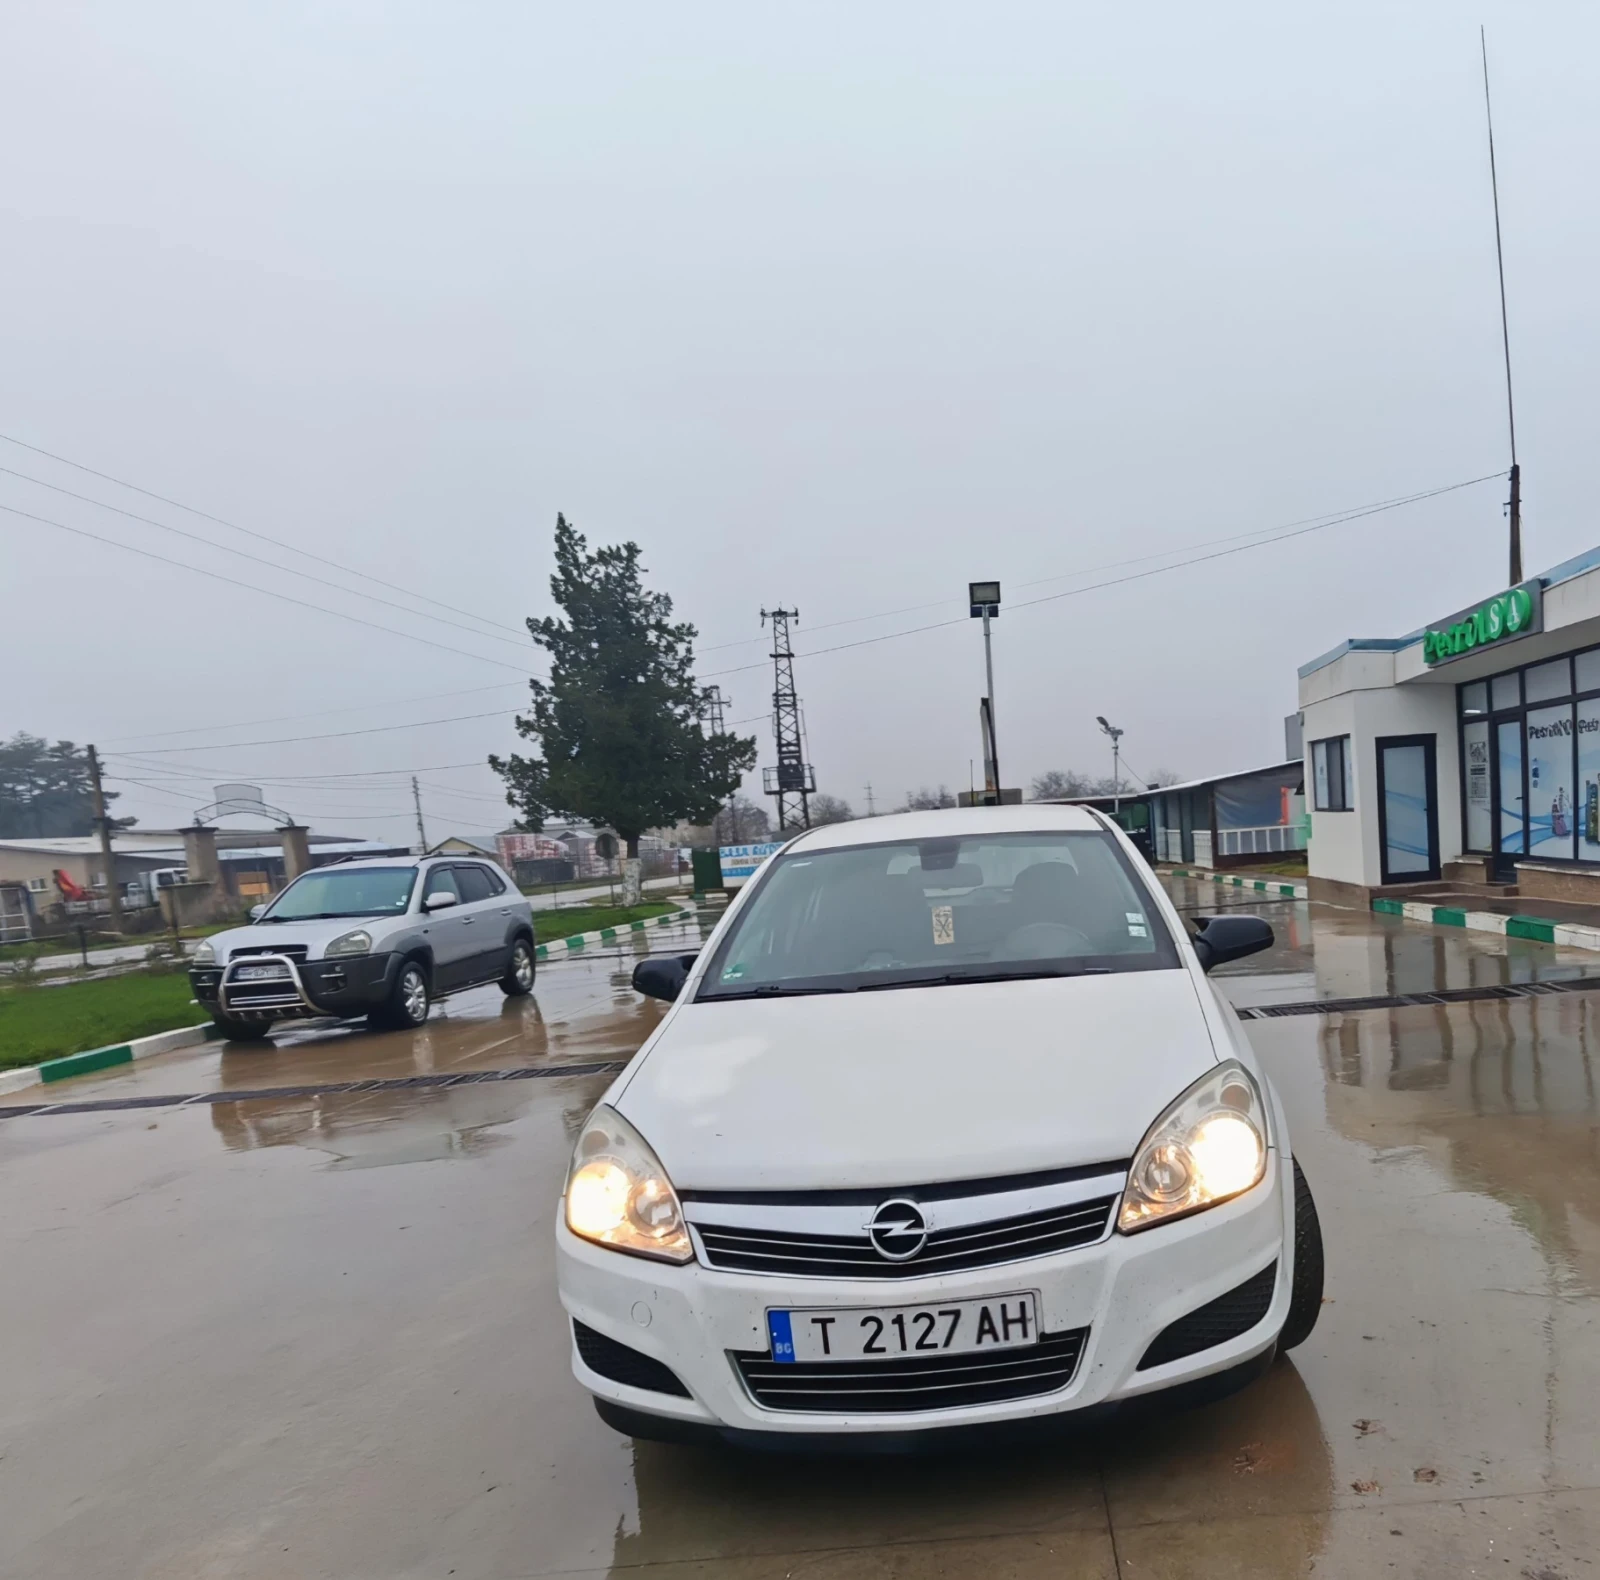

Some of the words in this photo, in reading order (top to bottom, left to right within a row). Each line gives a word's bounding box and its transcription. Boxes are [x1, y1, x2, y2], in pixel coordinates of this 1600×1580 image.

[811, 1317, 836, 1355] T
[859, 1308, 961, 1354] 2127
[975, 1301, 1029, 1345] AH
[775, 1342, 792, 1354] BG
